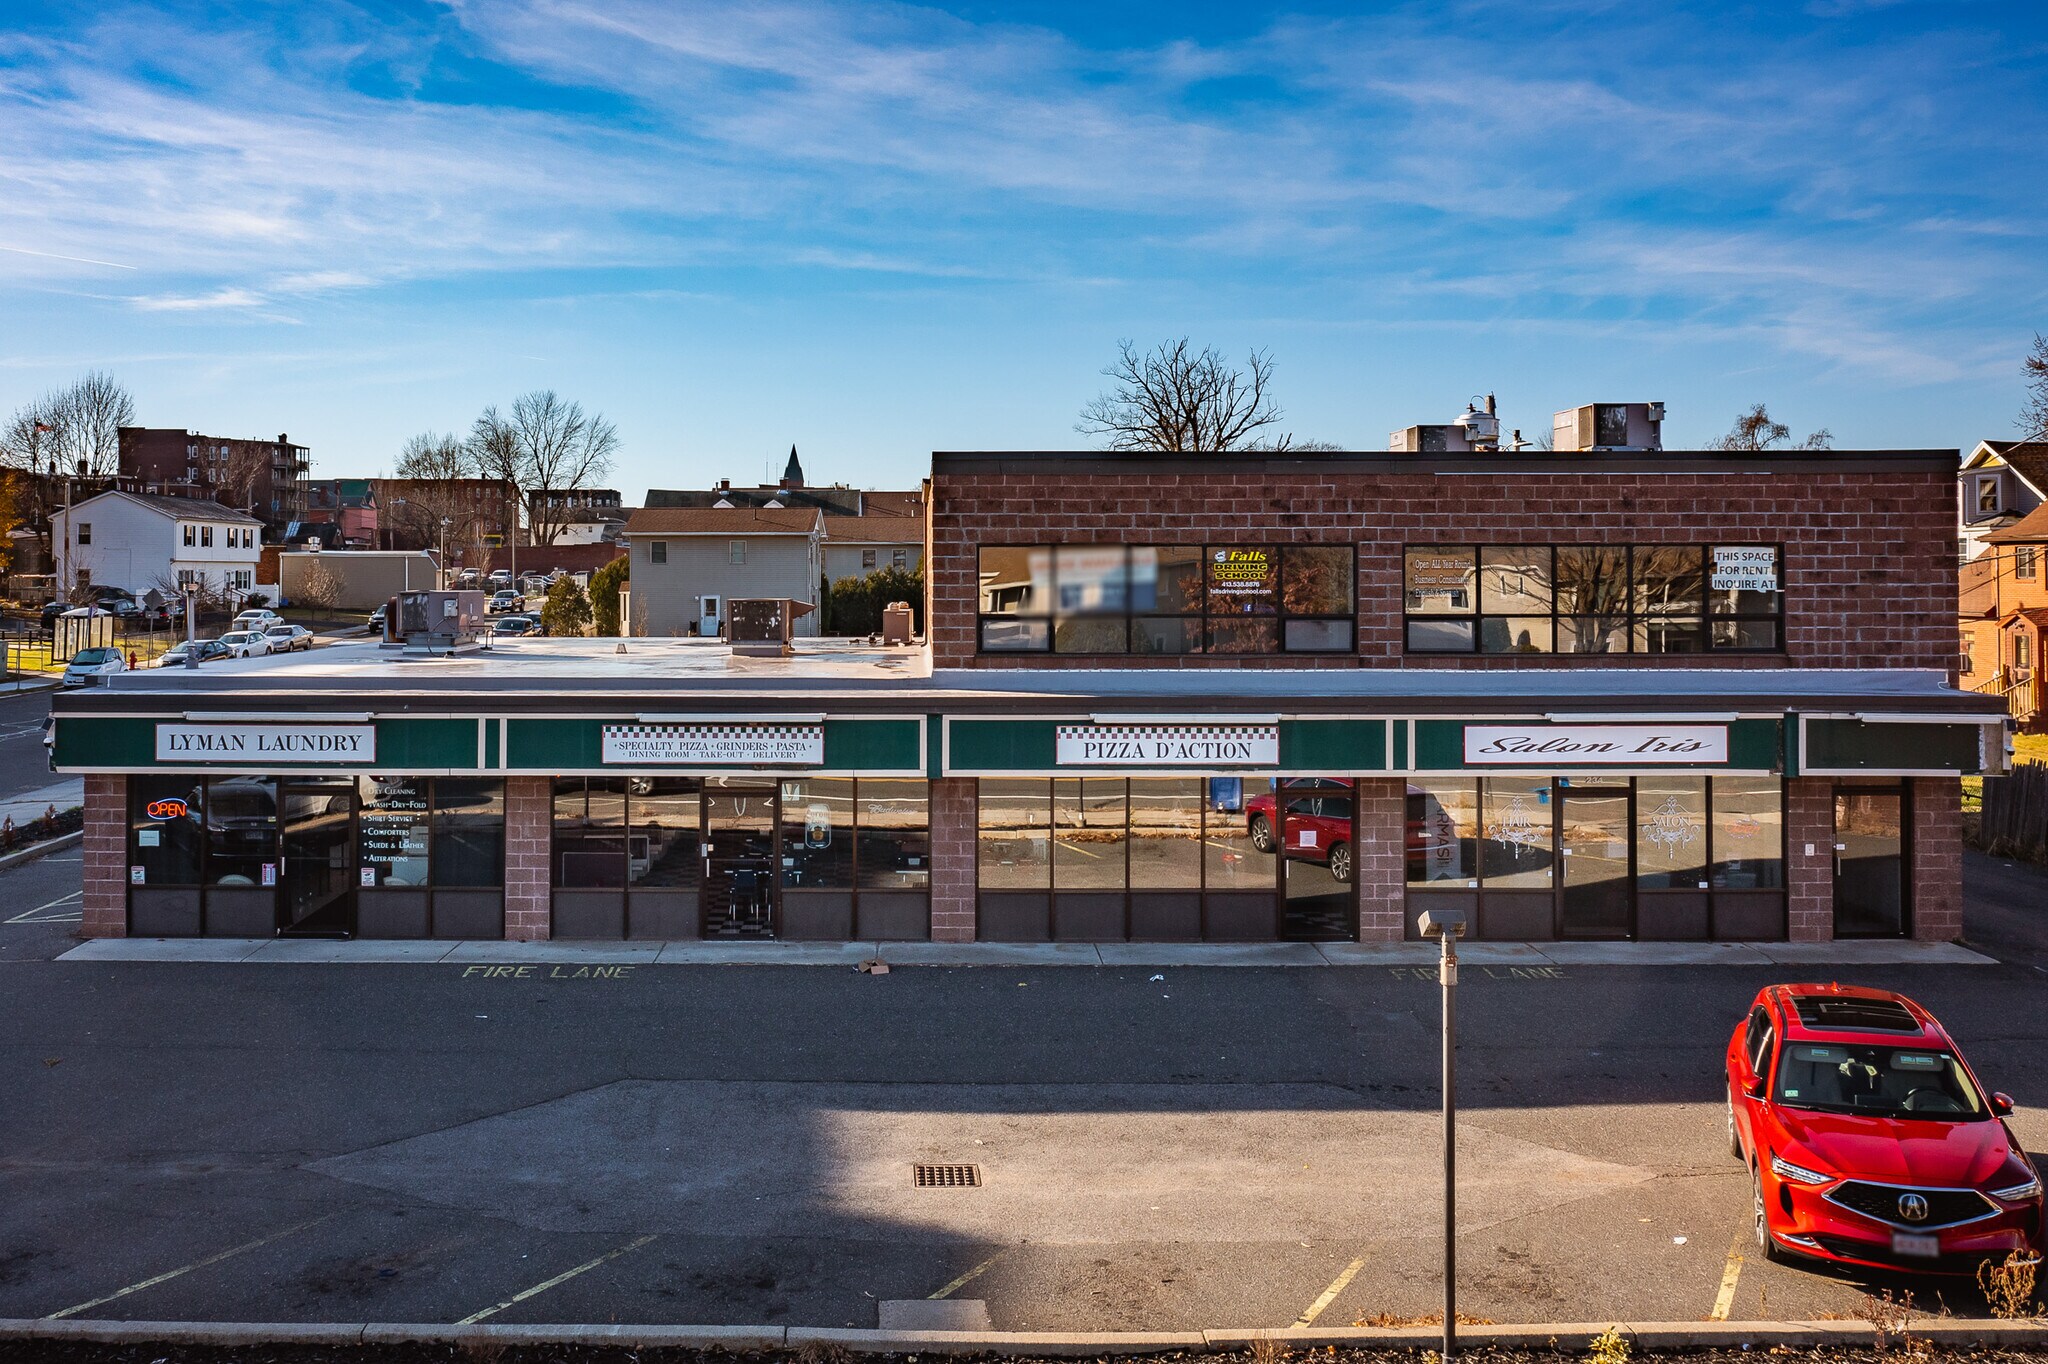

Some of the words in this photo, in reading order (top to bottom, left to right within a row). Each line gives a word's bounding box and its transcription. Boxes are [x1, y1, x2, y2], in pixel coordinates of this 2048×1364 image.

[1229, 551, 1267, 561] Falls
[1716, 552, 1739, 561] THIS
[1742, 552, 1774, 561] SPACE
[1214, 563, 1268, 571] DRIVING
[1415, 559, 1429, 571] Open
[1442, 560, 1454, 569] Year
[1454, 559, 1471, 569] Round
[1719, 566, 1740, 575] FOR
[1743, 566, 1770, 575] RENT
[1215, 572, 1267, 580] SCHOOL
[1414, 574, 1437, 584] Business
[1760, 580, 1775, 589] AT
[1209, 588, 1272, 596] fallsdrivingschool.com
[169, 734, 246, 751] LYMAN
[257, 734, 363, 751] LAUNDRY
[618, 741, 674, 751] SPECIALTY
[679, 741, 709, 751] PIZZA
[716, 742, 769, 751] GRINDERS
[776, 742, 807, 751] PASTA
[1478, 736, 1624, 754] Salon
[1627, 736, 1713, 754] Iris
[753, 751, 798, 759] DELIVERY
[1083, 742, 1145, 759] PIZZA
[1156, 742, 1252, 759] D'ACTION
[384, 787, 416, 795] CLEANING
[147, 801, 187, 817] OPEN
[368, 800, 427, 809] WASH-DRY-FOLD
[367, 814, 386, 822] SHIRT
[388, 814, 413, 822] SERVICE
[1503, 816, 1532, 828] HAIR
[1652, 816, 1691, 827] SALON
[367, 827, 410, 836] COMFORTERS
[368, 841, 389, 849] SUEDE
[398, 841, 425, 849] LEATHER
[368, 854, 409, 862] ALTERATIONS
[462, 966, 537, 978] FIRE
[550, 966, 636, 979] LANE
[1389, 968, 1442, 980] FIR
[1482, 967, 1573, 980] LANE
